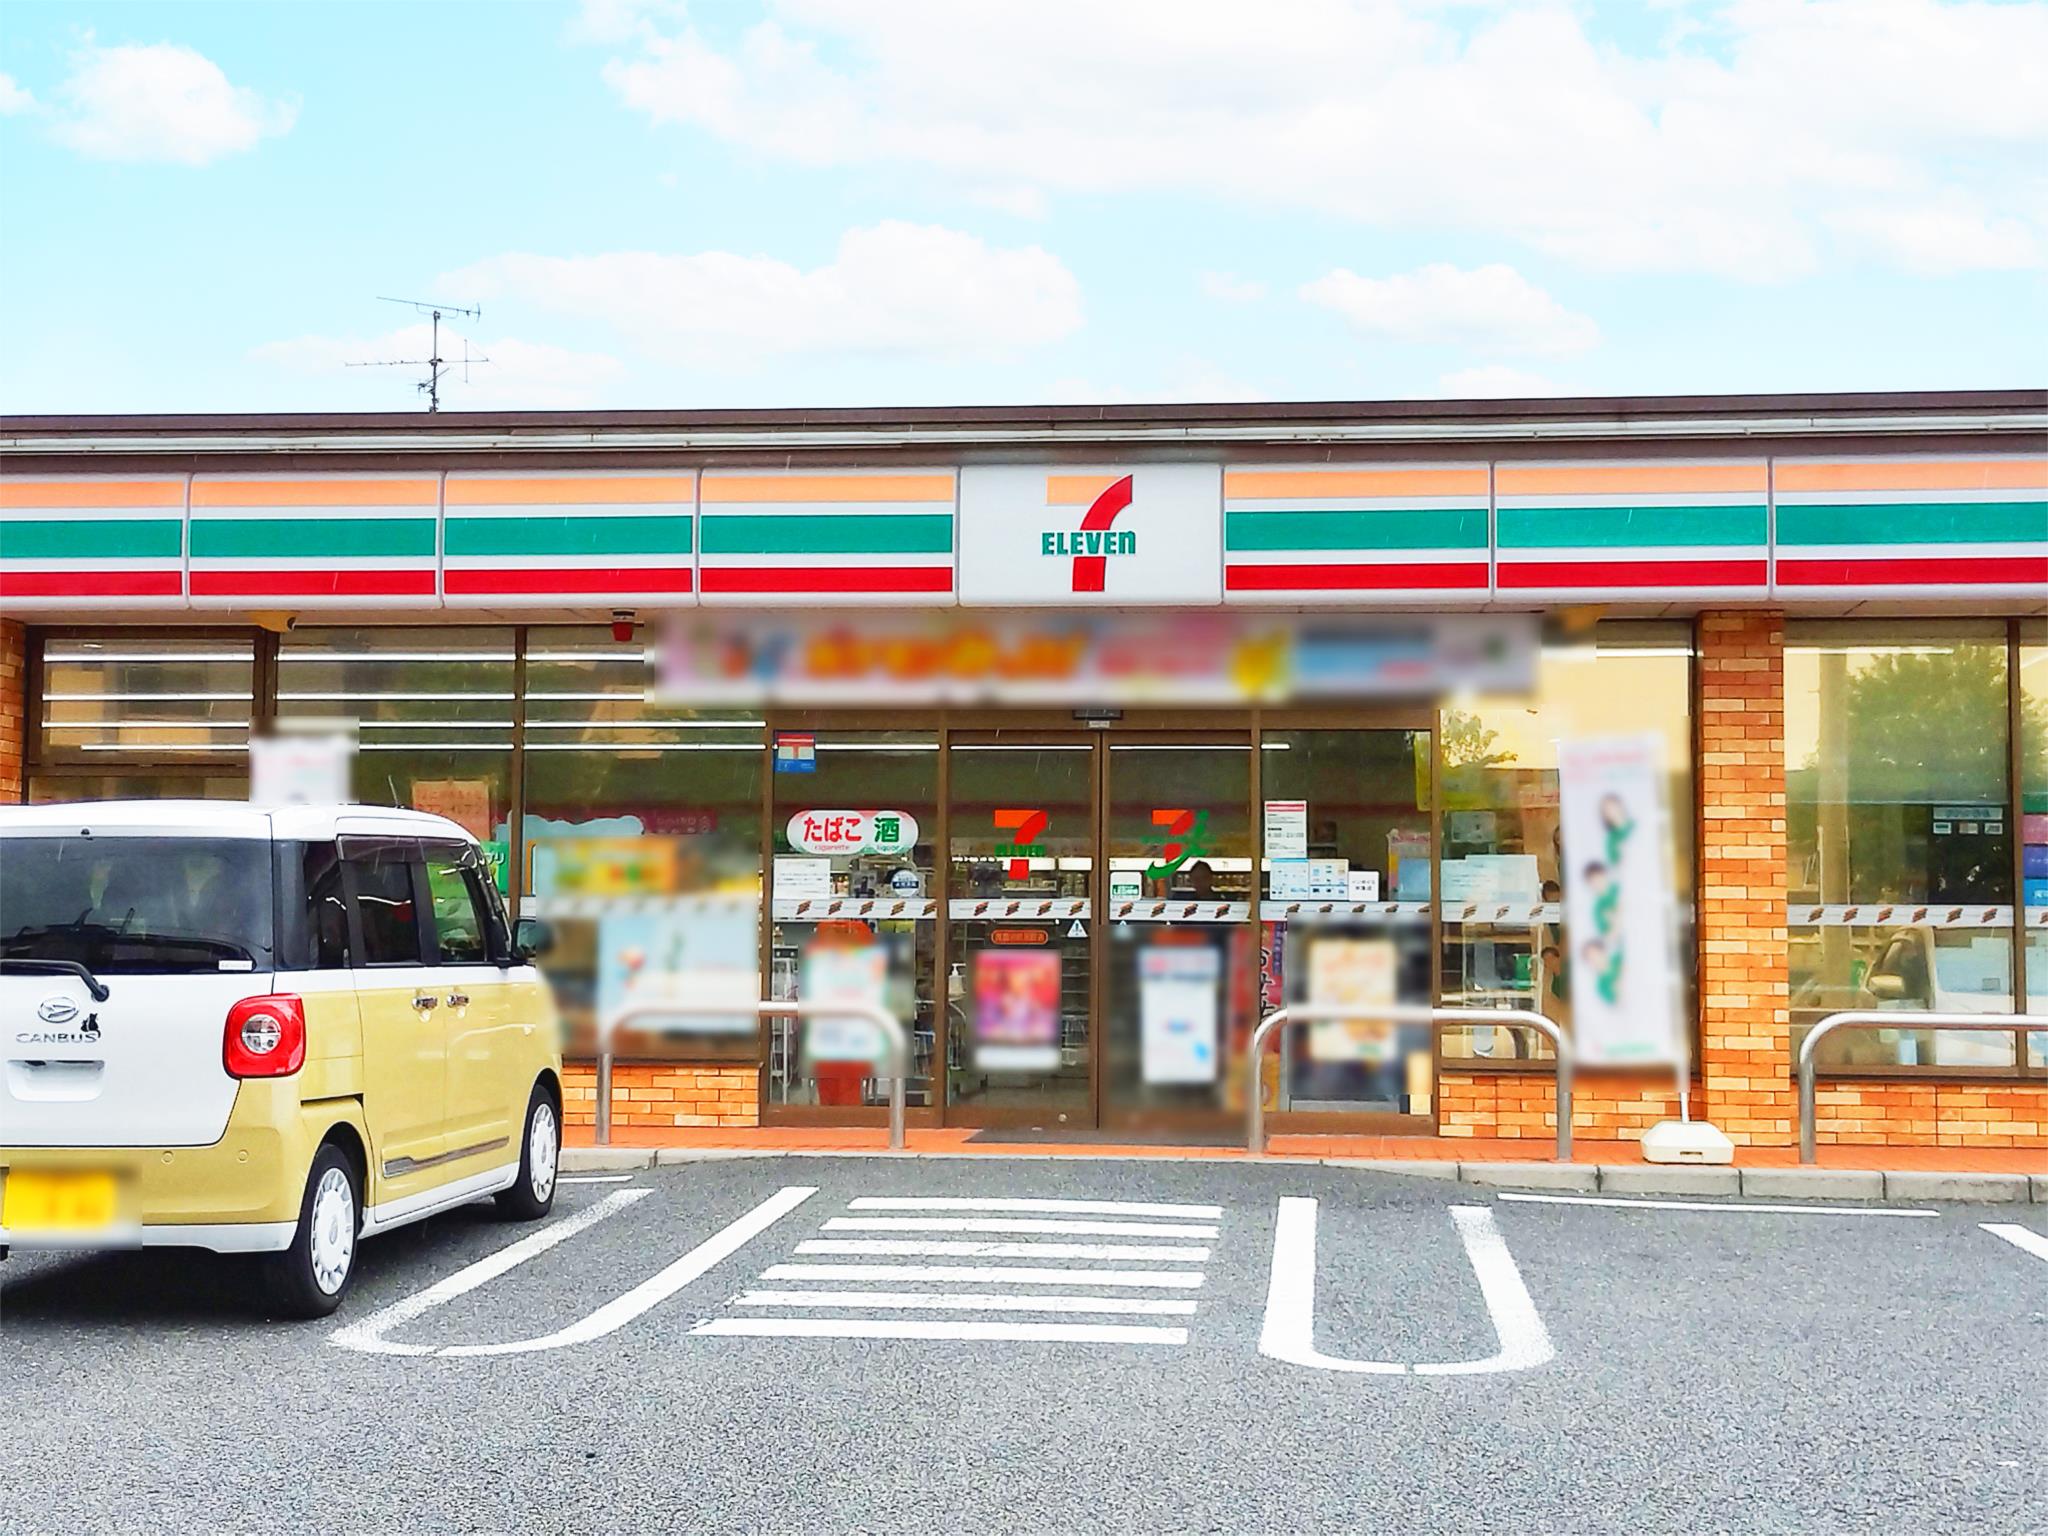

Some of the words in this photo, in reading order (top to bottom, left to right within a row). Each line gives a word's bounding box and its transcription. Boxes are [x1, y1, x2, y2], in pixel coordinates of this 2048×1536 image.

[803, 816, 862, 842] たばこ
[874, 817, 900, 842] 酒
[15, 1033, 97, 1044] CANBUS
